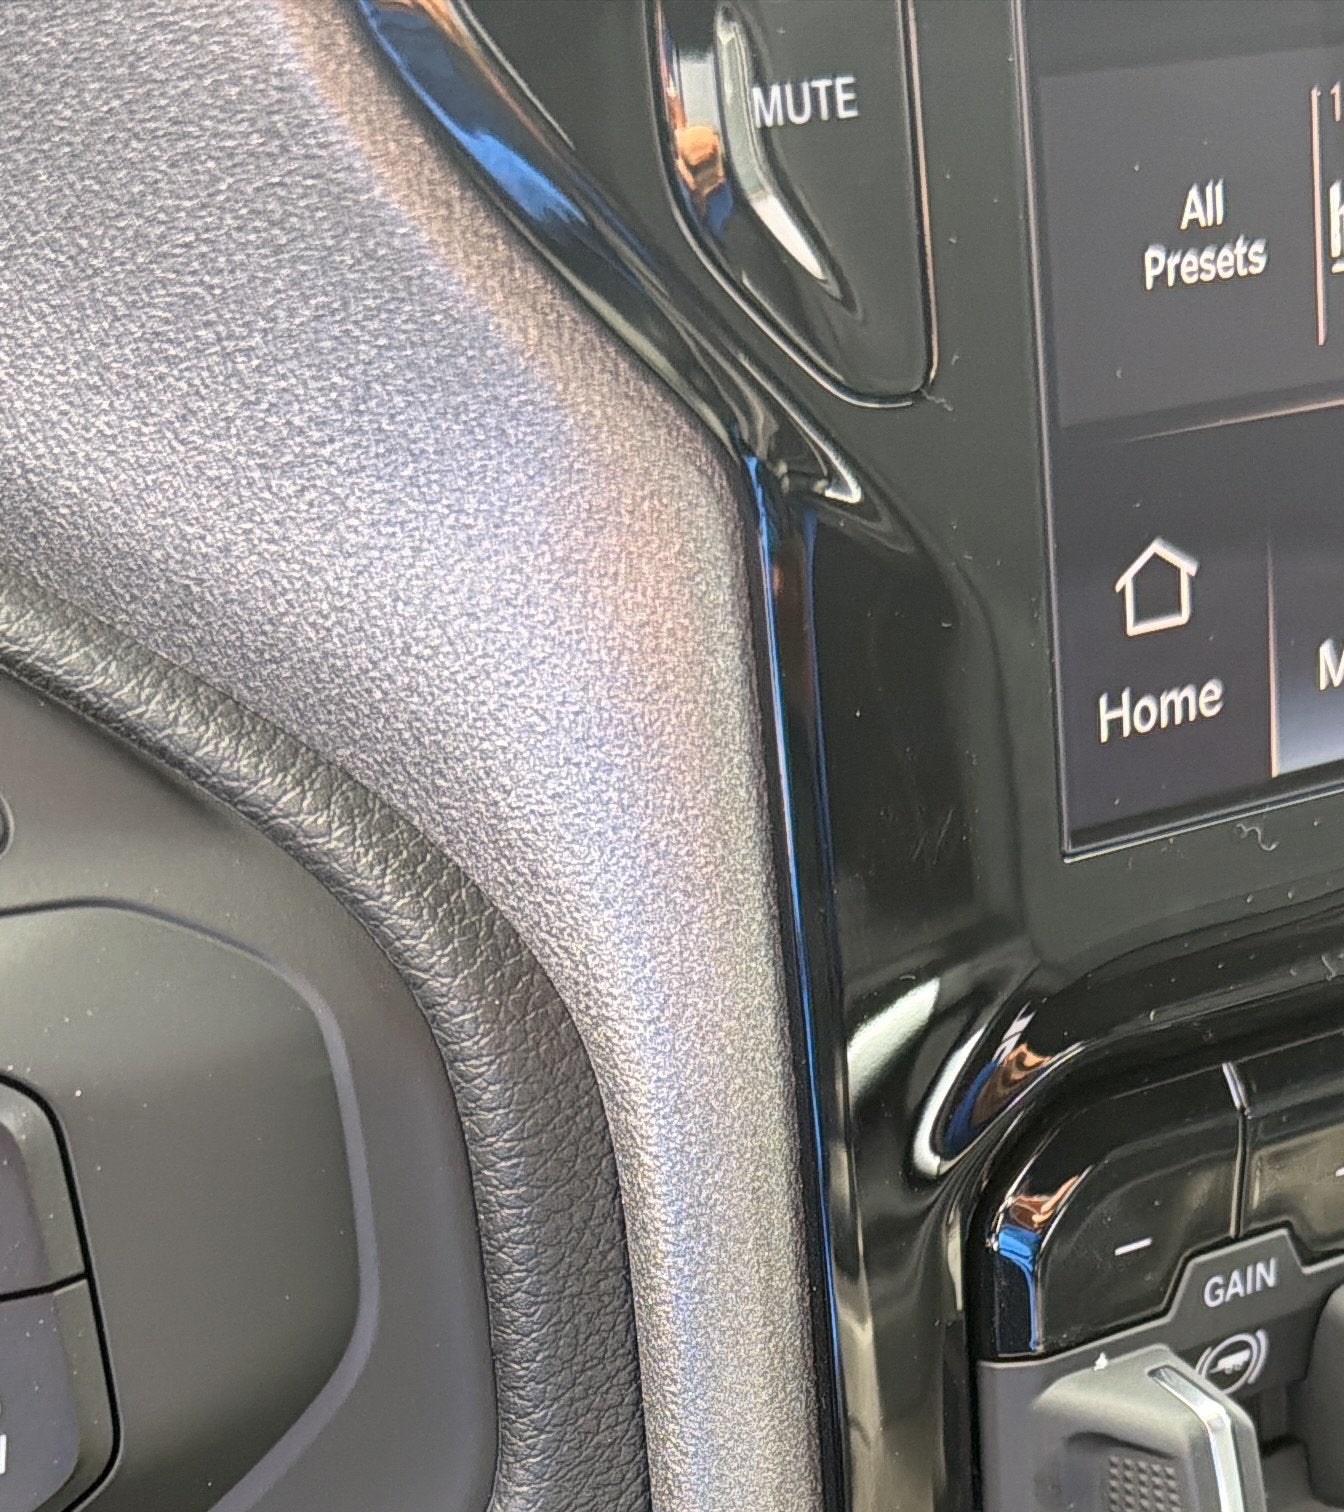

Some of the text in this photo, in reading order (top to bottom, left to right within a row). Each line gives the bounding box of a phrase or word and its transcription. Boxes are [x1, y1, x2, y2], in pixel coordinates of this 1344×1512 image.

[752, 75, 859, 128] MUTE
[1330, 80, 1343, 122] 1
[1181, 178, 1226, 231] All
[1144, 234, 1268, 291] Presets
[1098, 678, 1225, 743] Home
[1202, 1257, 1279, 1308] GAIN
